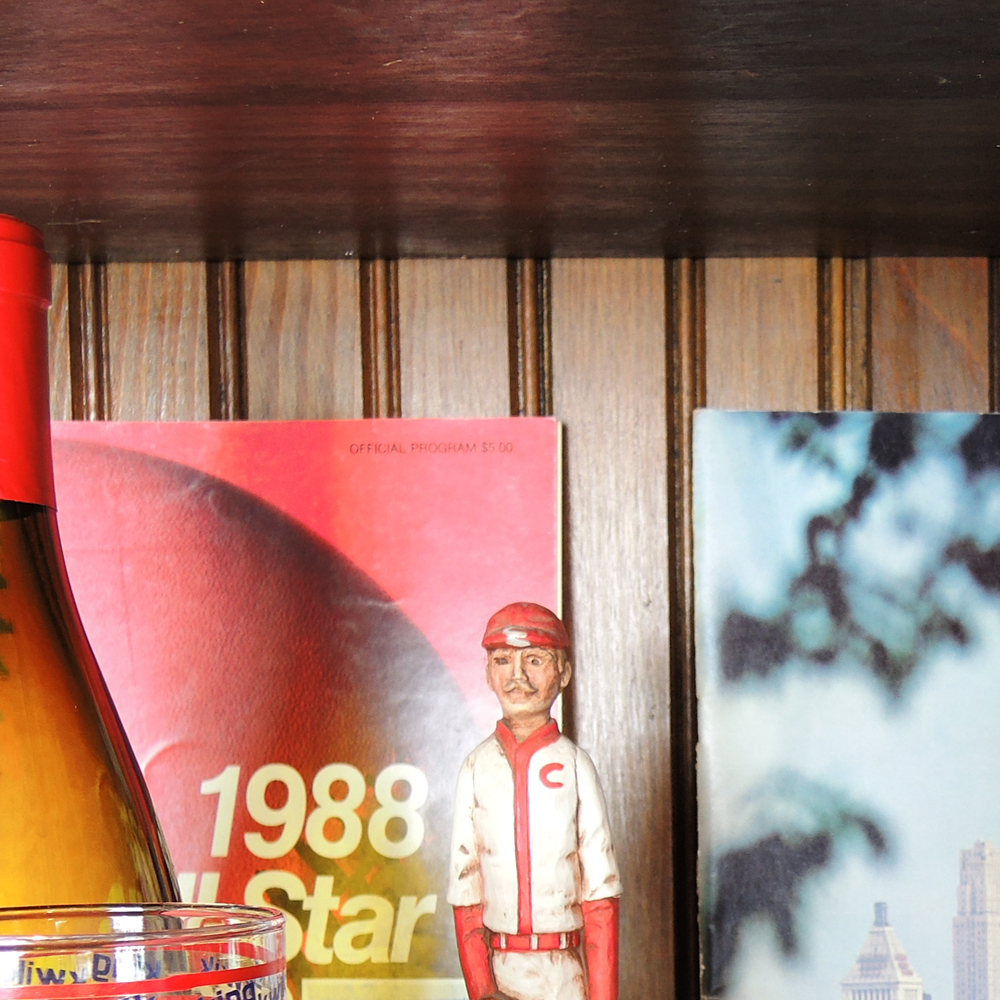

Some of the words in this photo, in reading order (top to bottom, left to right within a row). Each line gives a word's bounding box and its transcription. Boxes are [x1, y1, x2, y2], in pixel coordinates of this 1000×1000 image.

[349, 442, 406, 454] OFFICIAL
[410, 442, 477, 454] PROGRAM
[539, 762, 565, 789] C
[199, 762, 429, 860] 1988
[243, 869, 438, 965] Star
